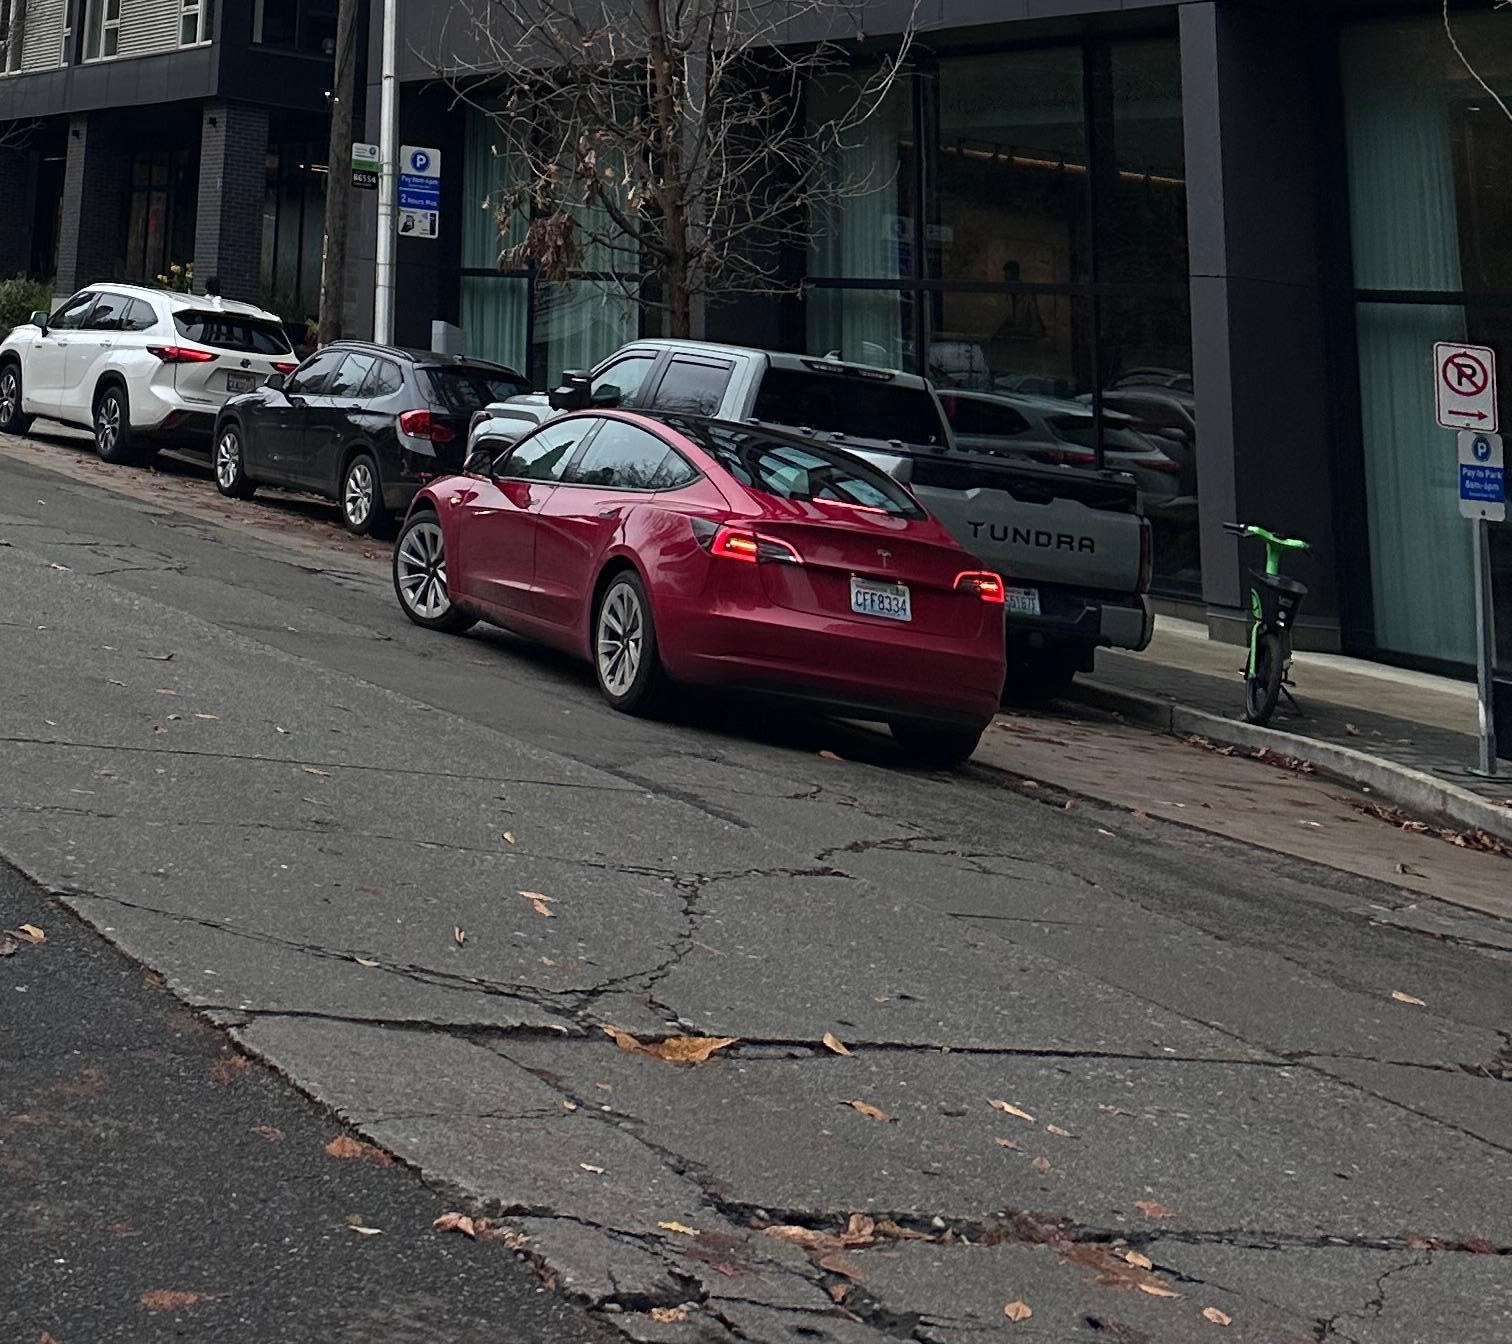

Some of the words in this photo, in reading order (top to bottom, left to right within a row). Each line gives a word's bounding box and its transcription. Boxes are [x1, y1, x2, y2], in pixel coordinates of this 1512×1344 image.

[401, 193, 407, 203] 2
[1462, 467, 1475, 480] Pay
[1476, 469, 1485, 478] to
[1485, 470, 1503, 479] Park
[968, 521, 1095, 553] TUNDRA
[855, 590, 907, 616] CFF8334
